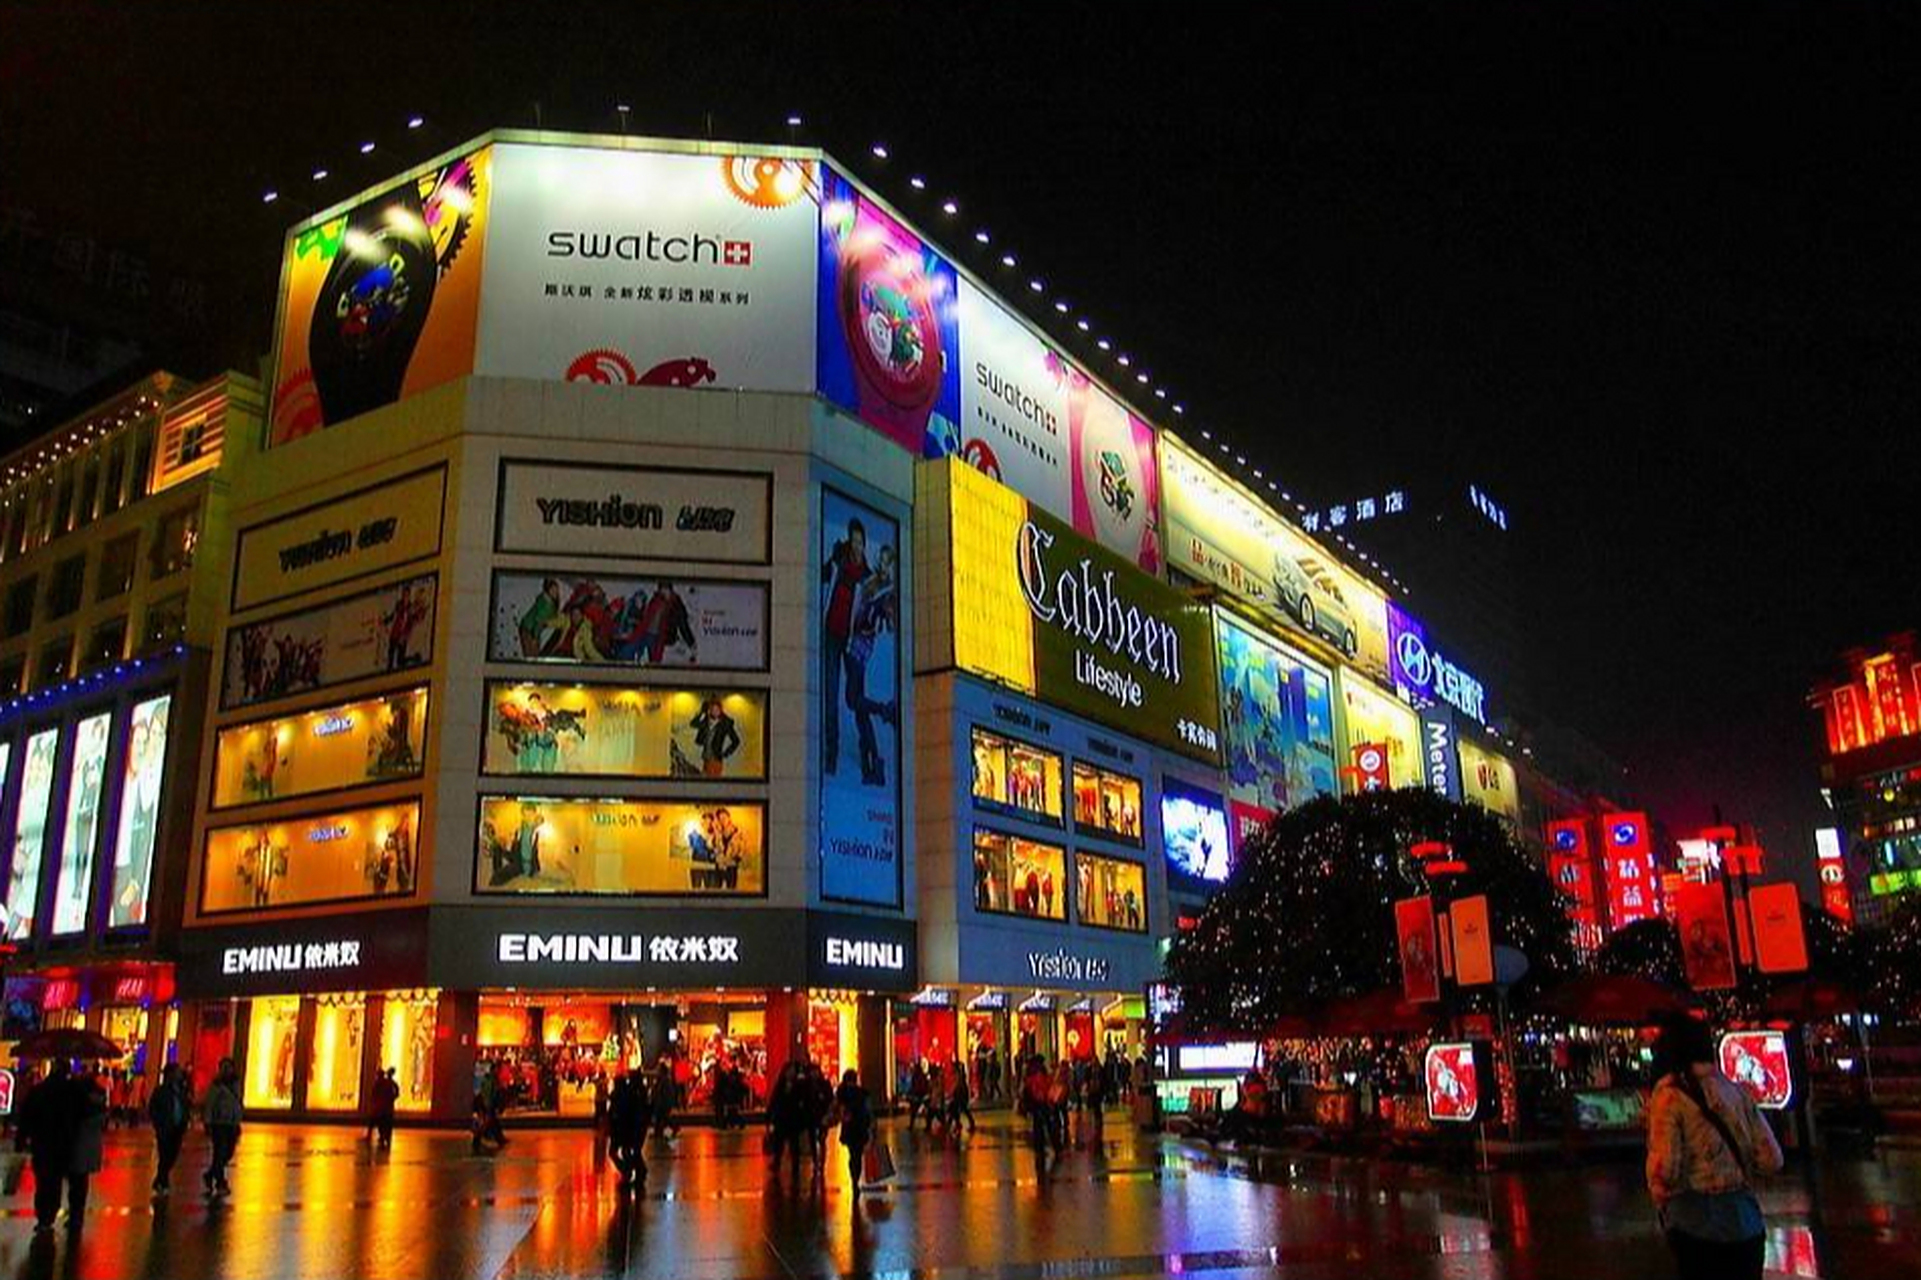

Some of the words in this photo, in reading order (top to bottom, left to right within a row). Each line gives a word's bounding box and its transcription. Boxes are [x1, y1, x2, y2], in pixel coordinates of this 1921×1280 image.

[547, 231, 718, 264] swatch
[975, 361, 1045, 429] swatch
[1017, 521, 1181, 686] Cabbeen
[1075, 650, 1143, 708] Lifestyle
[648, 935, 739, 963] 依米奴
